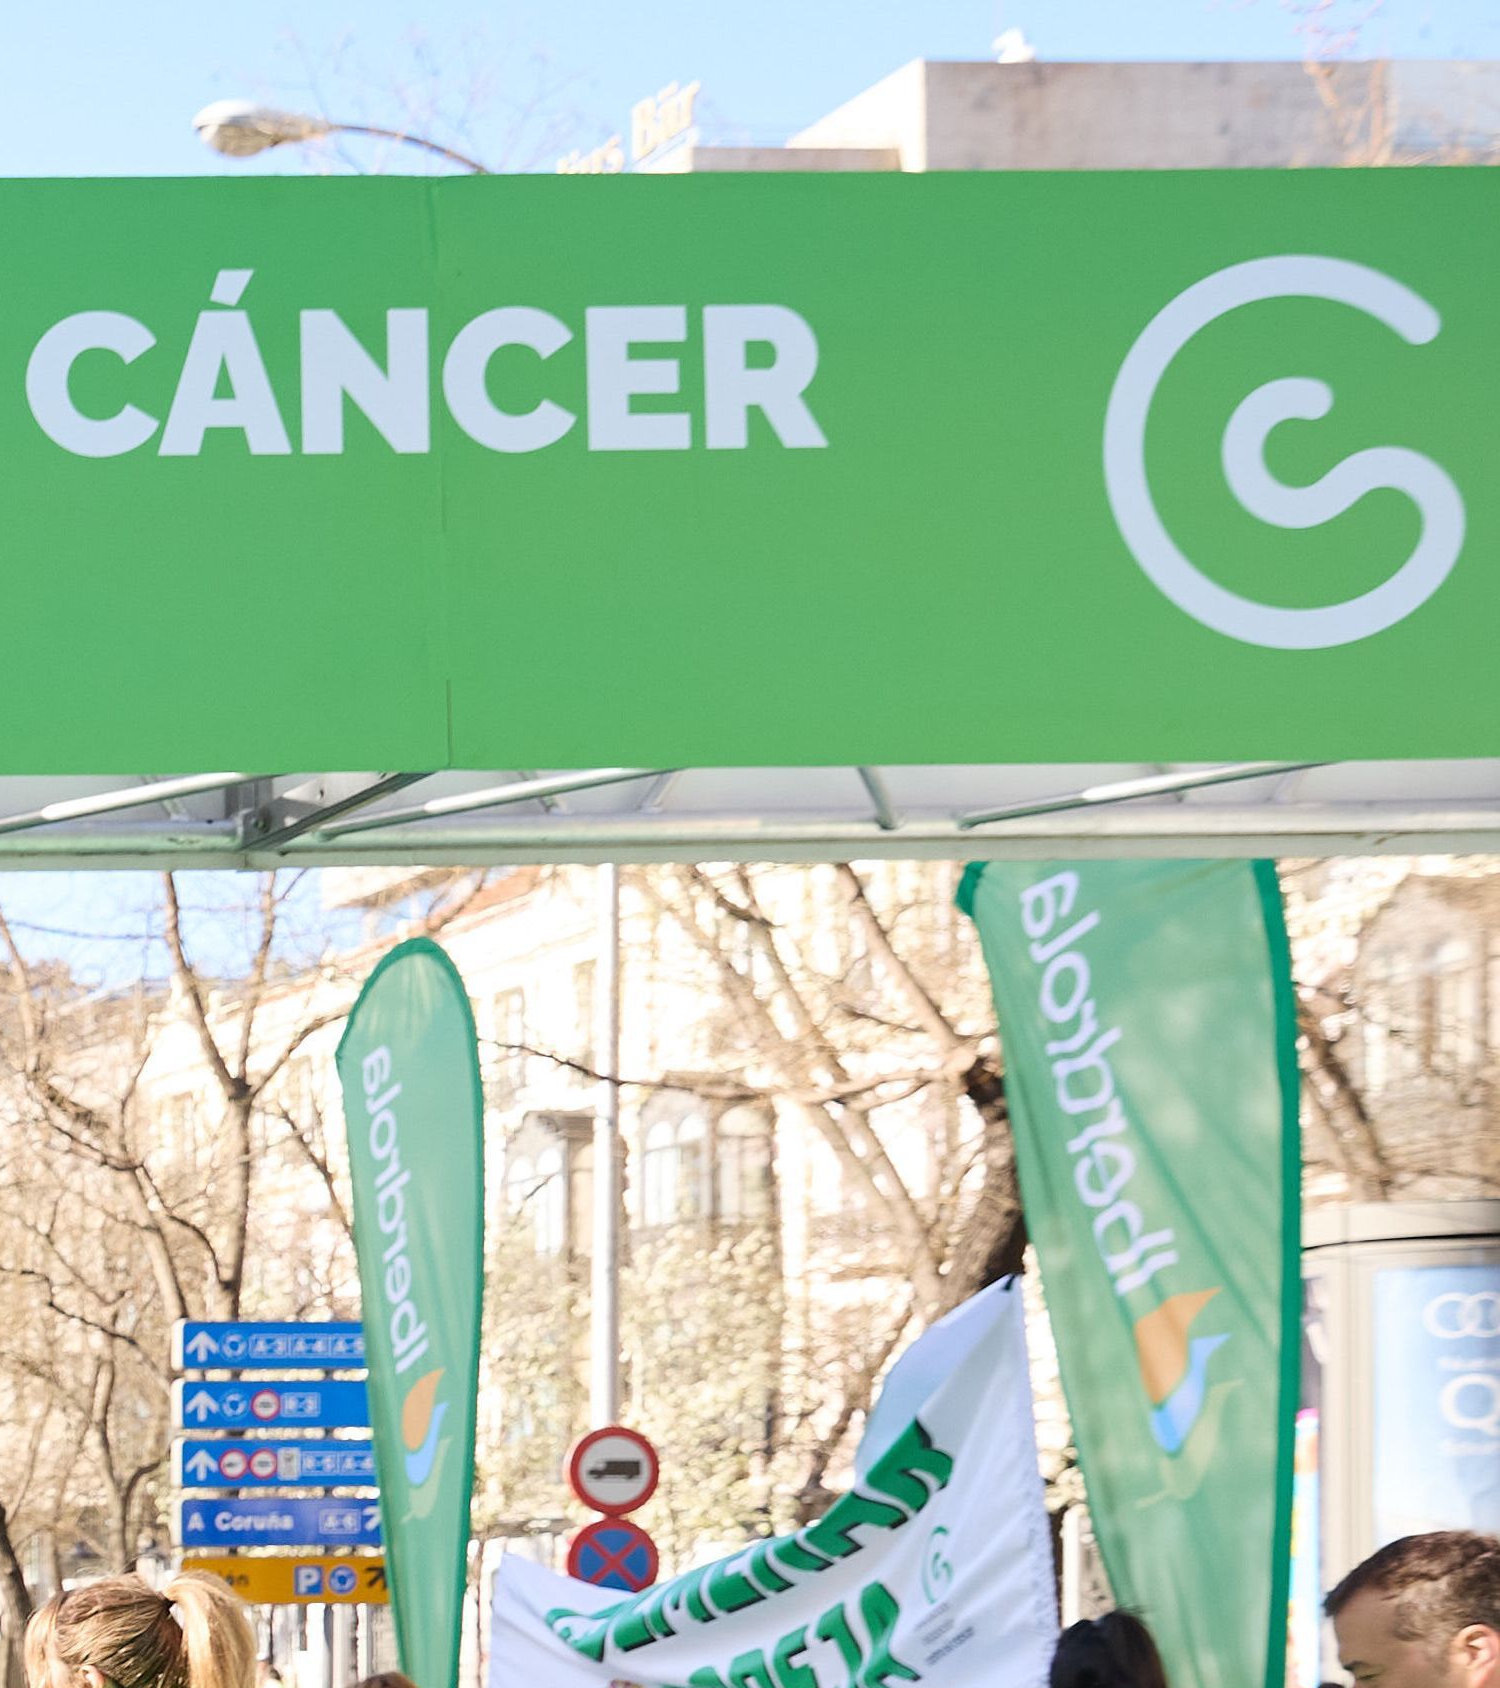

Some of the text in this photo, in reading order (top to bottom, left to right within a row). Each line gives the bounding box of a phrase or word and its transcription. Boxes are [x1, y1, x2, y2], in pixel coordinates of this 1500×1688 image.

[25, 267, 829, 459] CÁNCER
[187, 1512, 205, 1531] A
[214, 1508, 295, 1532] Coruña
